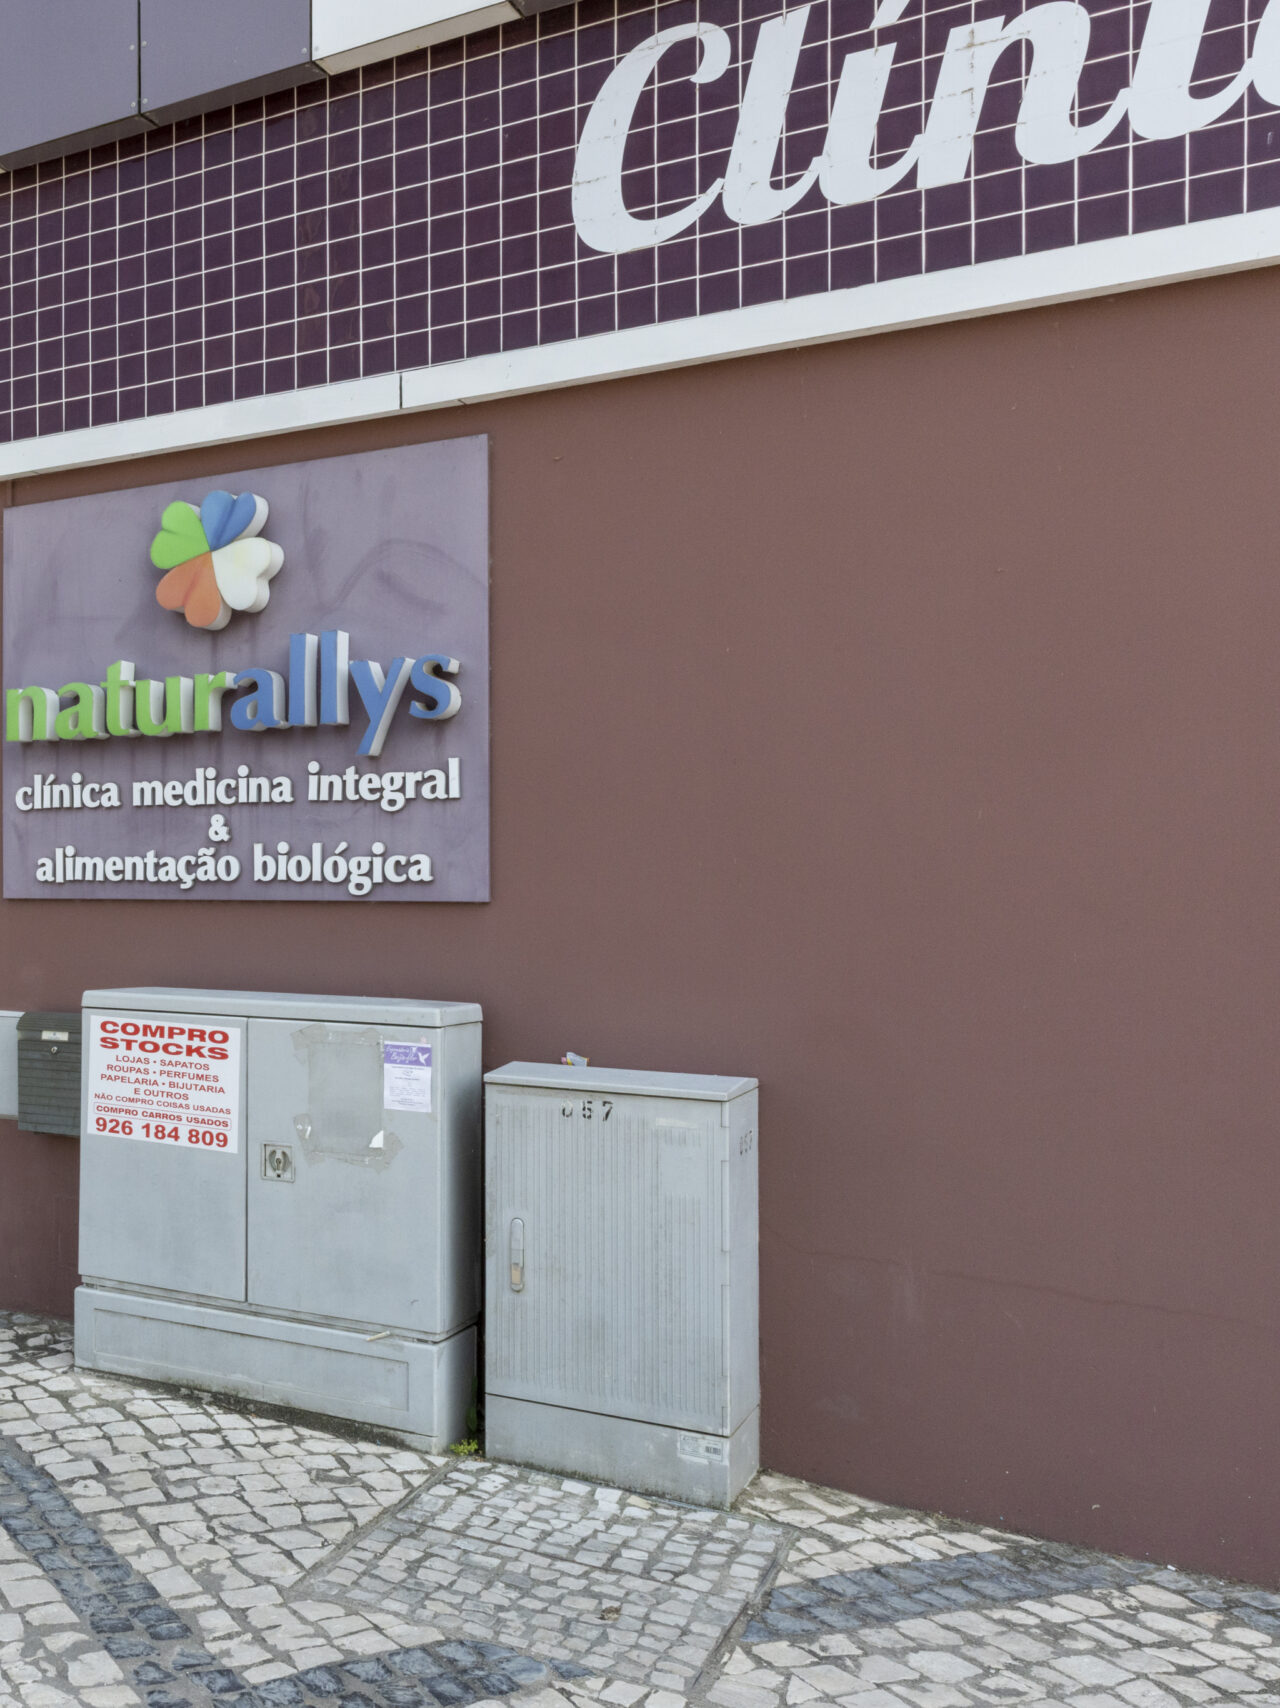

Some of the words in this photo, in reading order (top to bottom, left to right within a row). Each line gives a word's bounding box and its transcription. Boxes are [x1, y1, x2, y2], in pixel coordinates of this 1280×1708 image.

[6, 630, 462, 756] naturallys
[16, 772, 121, 812] clínica
[132, 765, 294, 808] medicina
[307, 757, 461, 812] integral
[208, 814, 231, 842] &
[36, 846, 240, 890] alimentação
[253, 842, 434, 896] biológica
[100, 1020, 229, 1044] COMPRO
[100, 1037, 229, 1060] STOCKS
[106, 1064, 150, 1075] ROUPAS
[160, 1070, 219, 1082] PERFUMES
[116, 1055, 150, 1064] LOJAS
[160, 1059, 210, 1071] SAPATOS
[100, 1074, 158, 1086] PAPELARIA
[169, 1081, 225, 1094] BIJUTARIA
[144, 1088, 189, 1100] OUTROS
[94, 1093, 113, 1101] NÃO
[115, 1096, 154, 1105] COMPRO
[156, 1100, 190, 1110] COISAS
[193, 1105, 231, 1115] USADAS
[96, 1105, 138, 1116] COMPRO
[142, 1111, 182, 1122] CARROS
[186, 1116, 229, 1128] USADOS
[95, 1117, 133, 1135] 926
[141, 1123, 180, 1142] 184
[188, 1129, 228, 1148] 809
